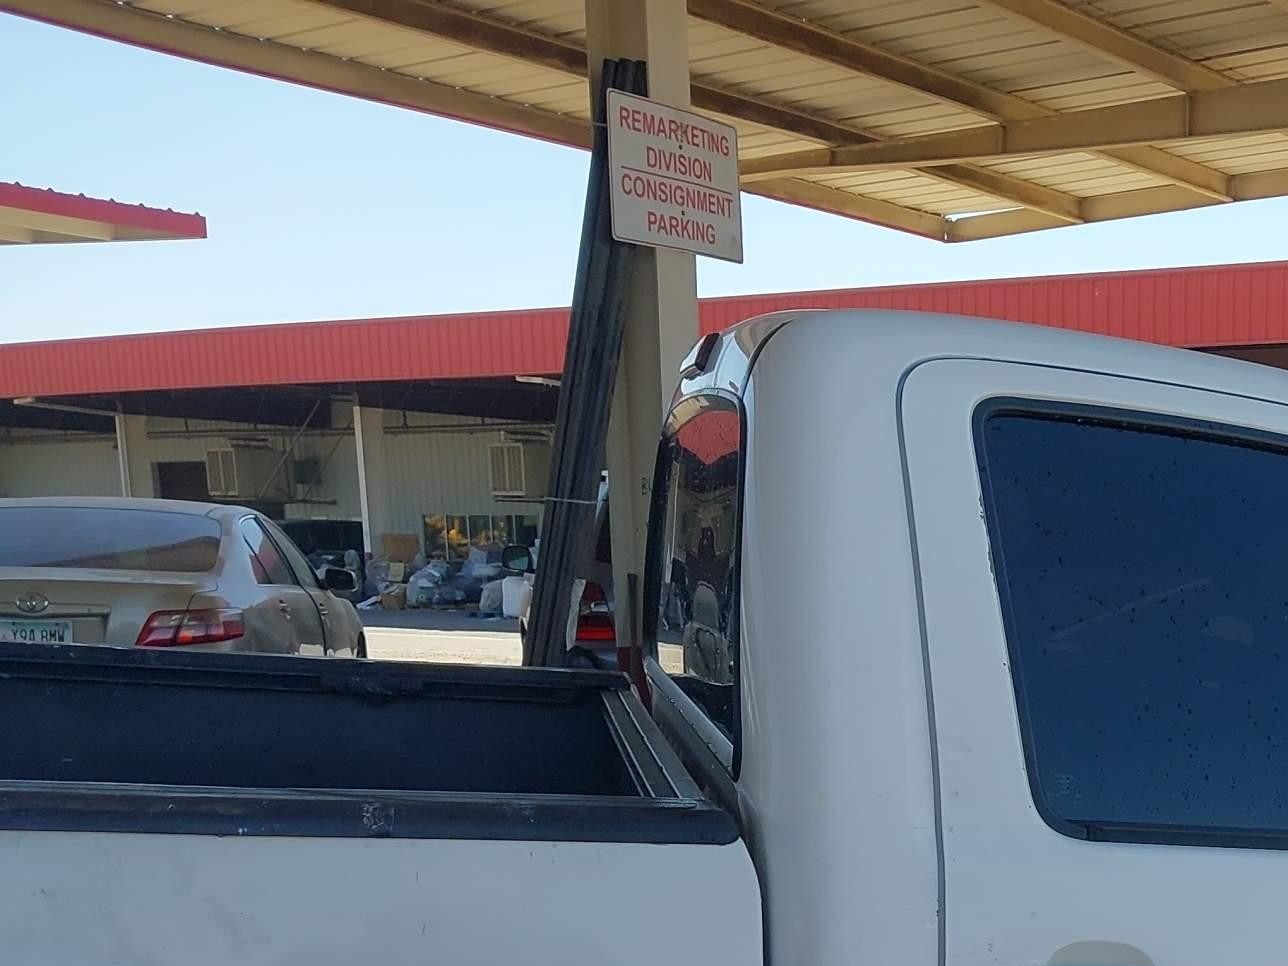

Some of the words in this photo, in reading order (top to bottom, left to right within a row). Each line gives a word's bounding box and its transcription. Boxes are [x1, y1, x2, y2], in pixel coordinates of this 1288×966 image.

[619, 106, 730, 156] REMARKETING
[646, 147, 712, 182] DIVISION
[621, 173, 733, 218] CONSIGNMENT
[647, 211, 716, 244] PARKING
